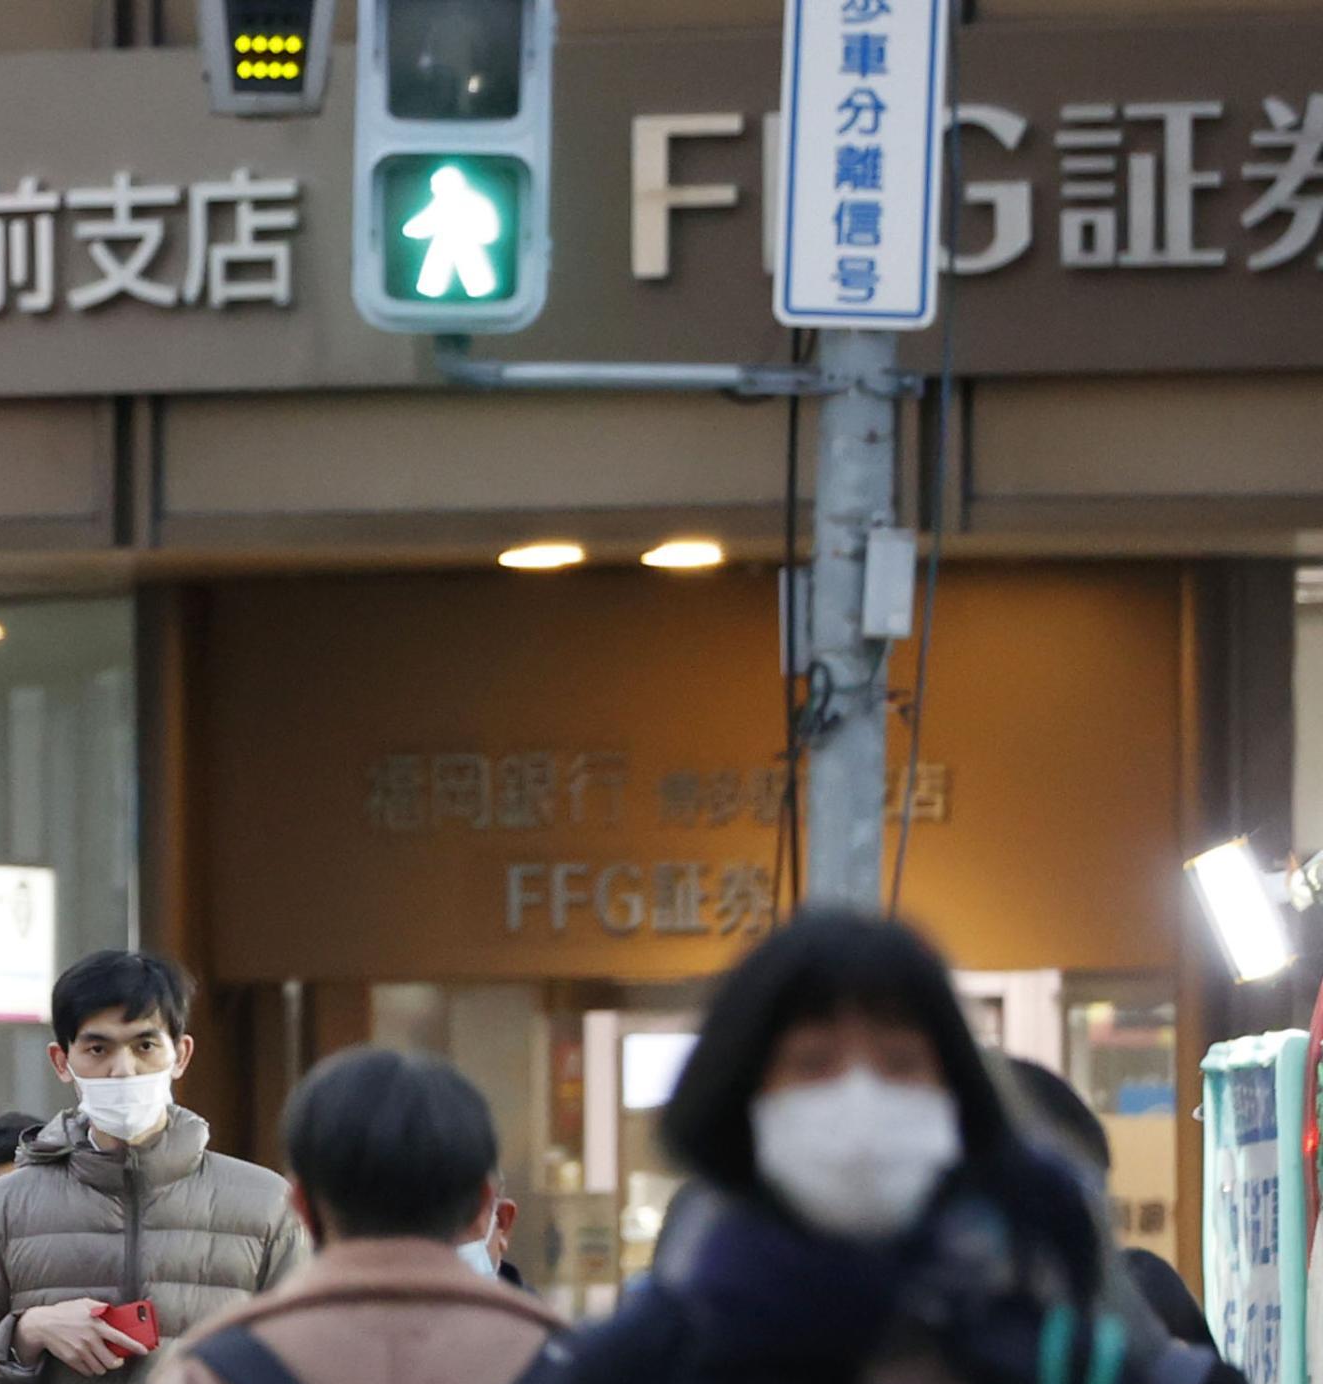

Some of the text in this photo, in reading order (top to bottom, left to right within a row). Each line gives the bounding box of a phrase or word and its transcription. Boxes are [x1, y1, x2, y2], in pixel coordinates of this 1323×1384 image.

[630, 93, 1323, 281] FG証
[367, 750, 947, 832] 福岡銀行 博多駅店
